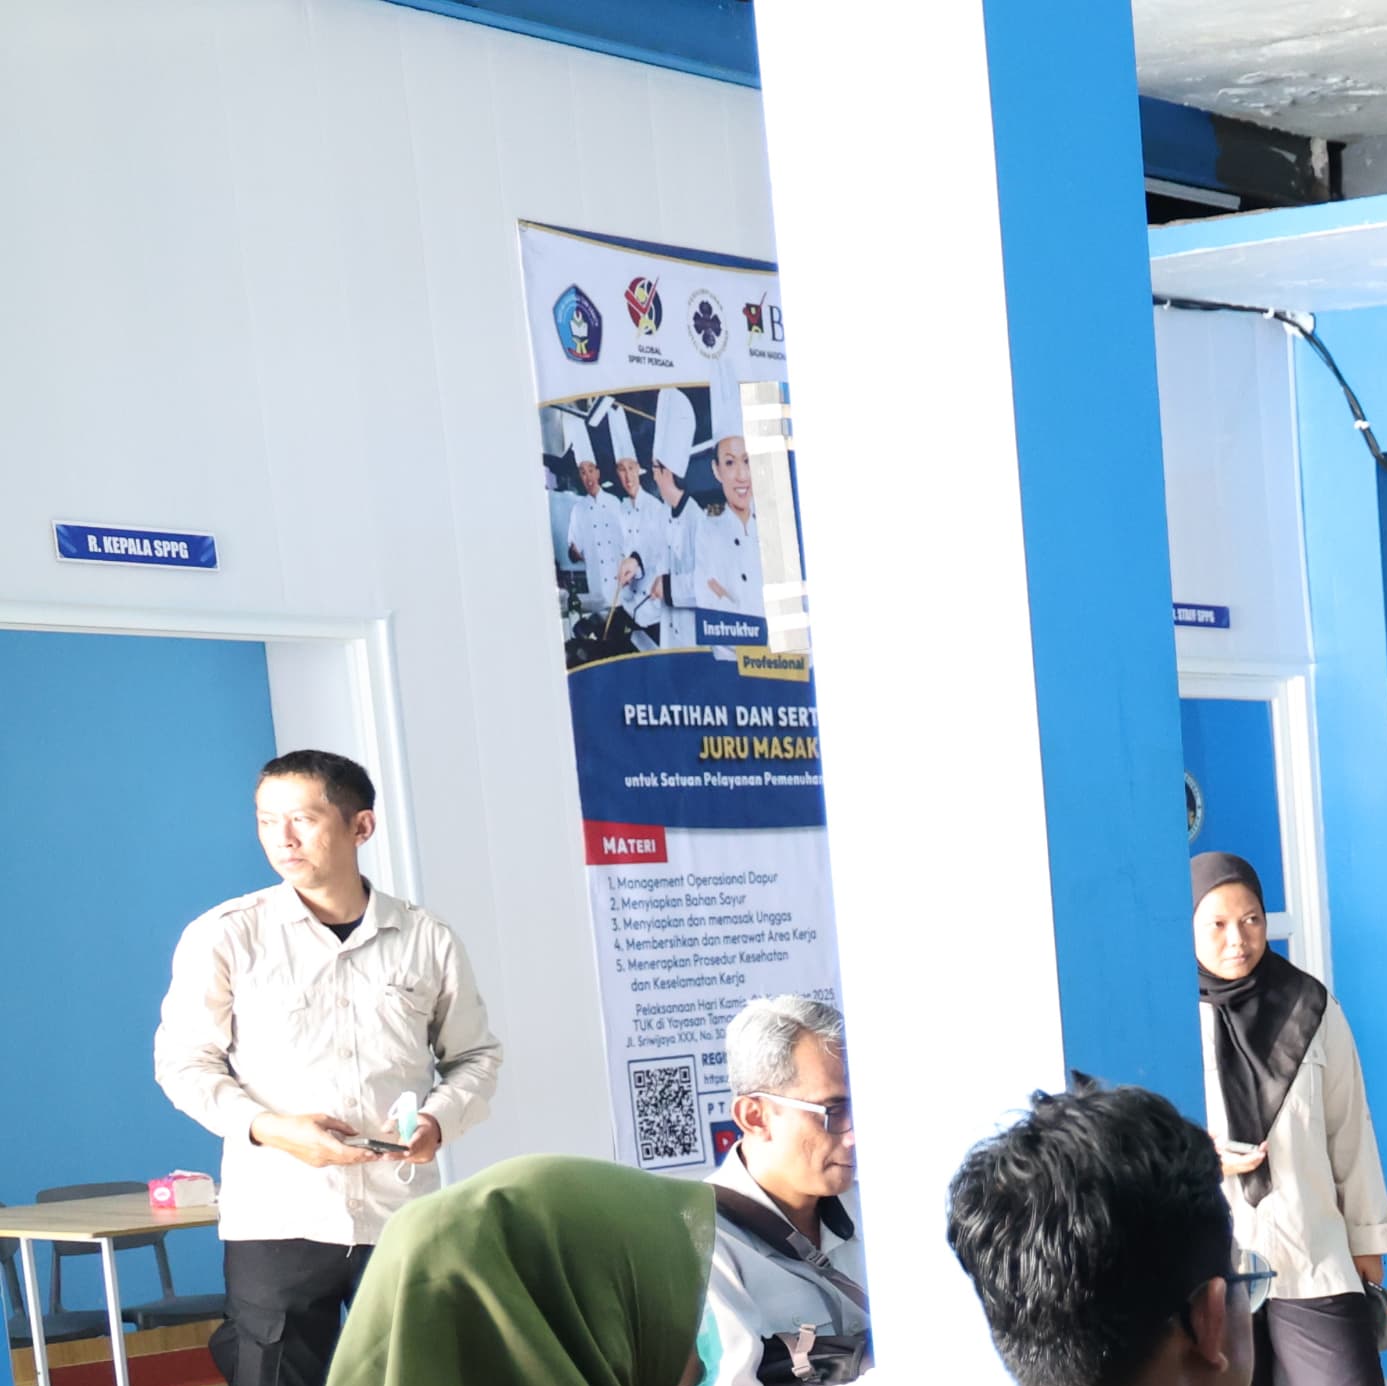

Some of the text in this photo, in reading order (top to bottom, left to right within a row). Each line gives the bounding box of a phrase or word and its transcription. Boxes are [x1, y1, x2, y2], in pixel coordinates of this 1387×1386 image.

[87, 534, 189, 559] R. KEPALA SPPG
[703, 620, 760, 638] Instruktur
[742, 655, 805, 670] Profesional
[624, 704, 728, 726] PELATIHAN
[736, 705, 773, 727] DAN
[699, 735, 820, 759] JURU MASAK
[624, 772, 659, 788] untuk
[661, 772, 702, 788] Satuan
[703, 772, 763, 790] Pelayanan
[602, 836, 656, 854] MATERI
[617, 875, 684, 892] Management
[687, 871, 747, 888] Operasional
[749, 871, 778, 886] Dapur
[621, 893, 683, 912] Menyiapkan
[684, 892, 717, 908] Bahan
[719, 891, 746, 907] Sayur
[623, 914, 684, 934] Menyiapkan
[687, 912, 707, 927] dan
[708, 910, 754, 926] memasak
[757, 910, 792, 926] Unggas
[626, 933, 700, 951] Membersihkan
[702, 932, 721, 948] dan
[723, 930, 766, 944] merawat
[768, 928, 791, 942] Area
[793, 928, 817, 943] Kerja
[628, 956, 691, 974] Menerapkan
[693, 953, 737, 967] Prosedur
[739, 949, 789, 964] Kesehatan
[631, 972, 745, 992] dan Keselamatan Kerja
[635, 1001, 696, 1016] Pelaksanaan
[697, 998, 717, 1010] Hari
[632, 1018, 654, 1032] TUK
[656, 1017, 665, 1030] di
[666, 1015, 706, 1030] Yayasan
